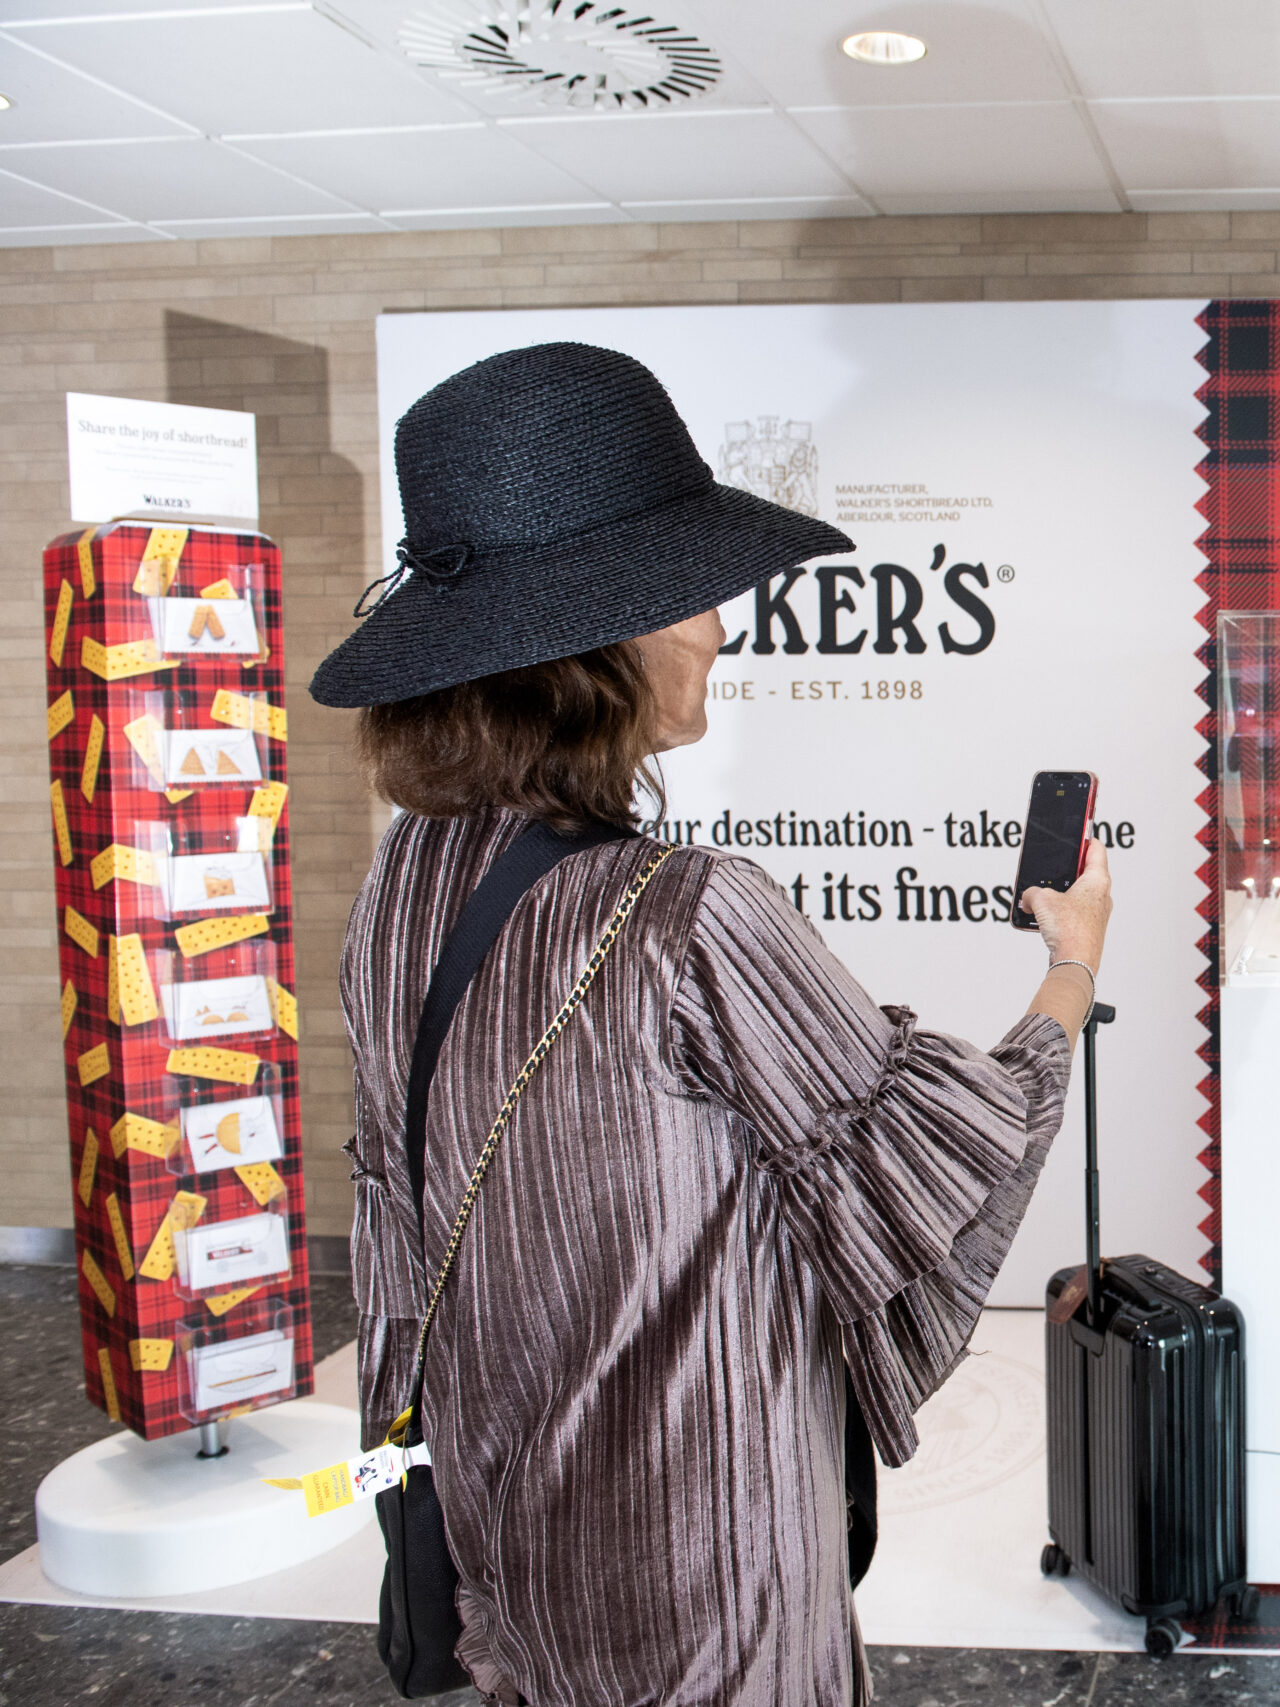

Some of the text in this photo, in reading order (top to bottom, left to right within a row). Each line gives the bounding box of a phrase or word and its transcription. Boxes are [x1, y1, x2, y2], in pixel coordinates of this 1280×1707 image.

[77, 419, 117, 436] Share
[118, 423, 140, 438] the
[142, 426, 160, 441] joy
[162, 428, 175, 442] of
[894, 498, 969, 508] SHORTBREAD
[899, 512, 961, 522] SCOTLAND
[792, 681, 849, 700] EST.
[861, 681, 923, 700] 1898
[640, 818, 702, 847] our
[711, 809, 913, 847] destination
[944, 809, 1022, 847] take
[791, 866, 1014, 923] t its fines
